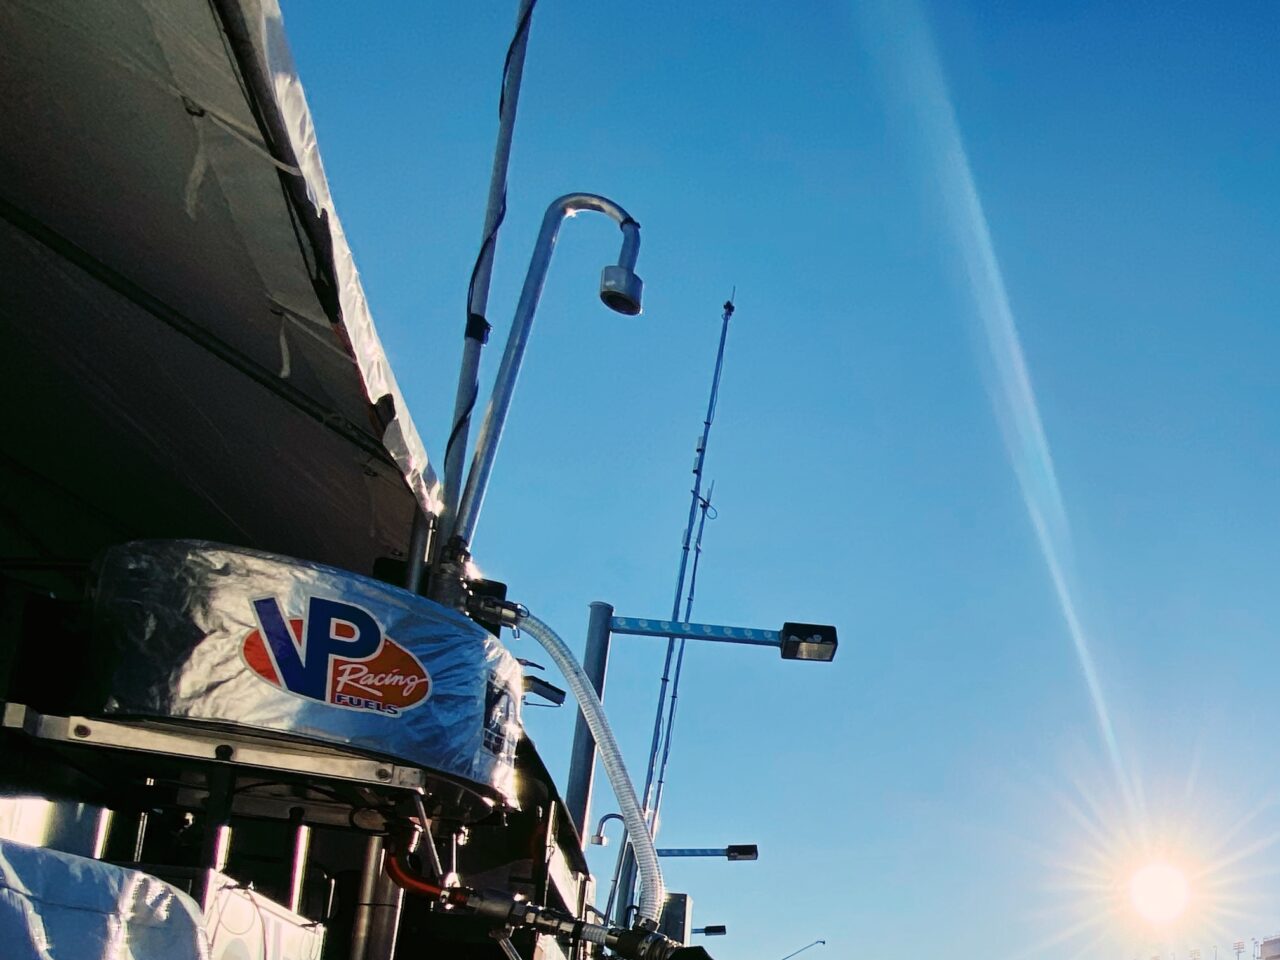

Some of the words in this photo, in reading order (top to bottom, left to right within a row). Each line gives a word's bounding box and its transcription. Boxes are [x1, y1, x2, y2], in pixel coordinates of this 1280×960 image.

[253, 596, 382, 702] VP
[336, 663, 430, 697] Racing
[335, 694, 399, 716] FUELS
